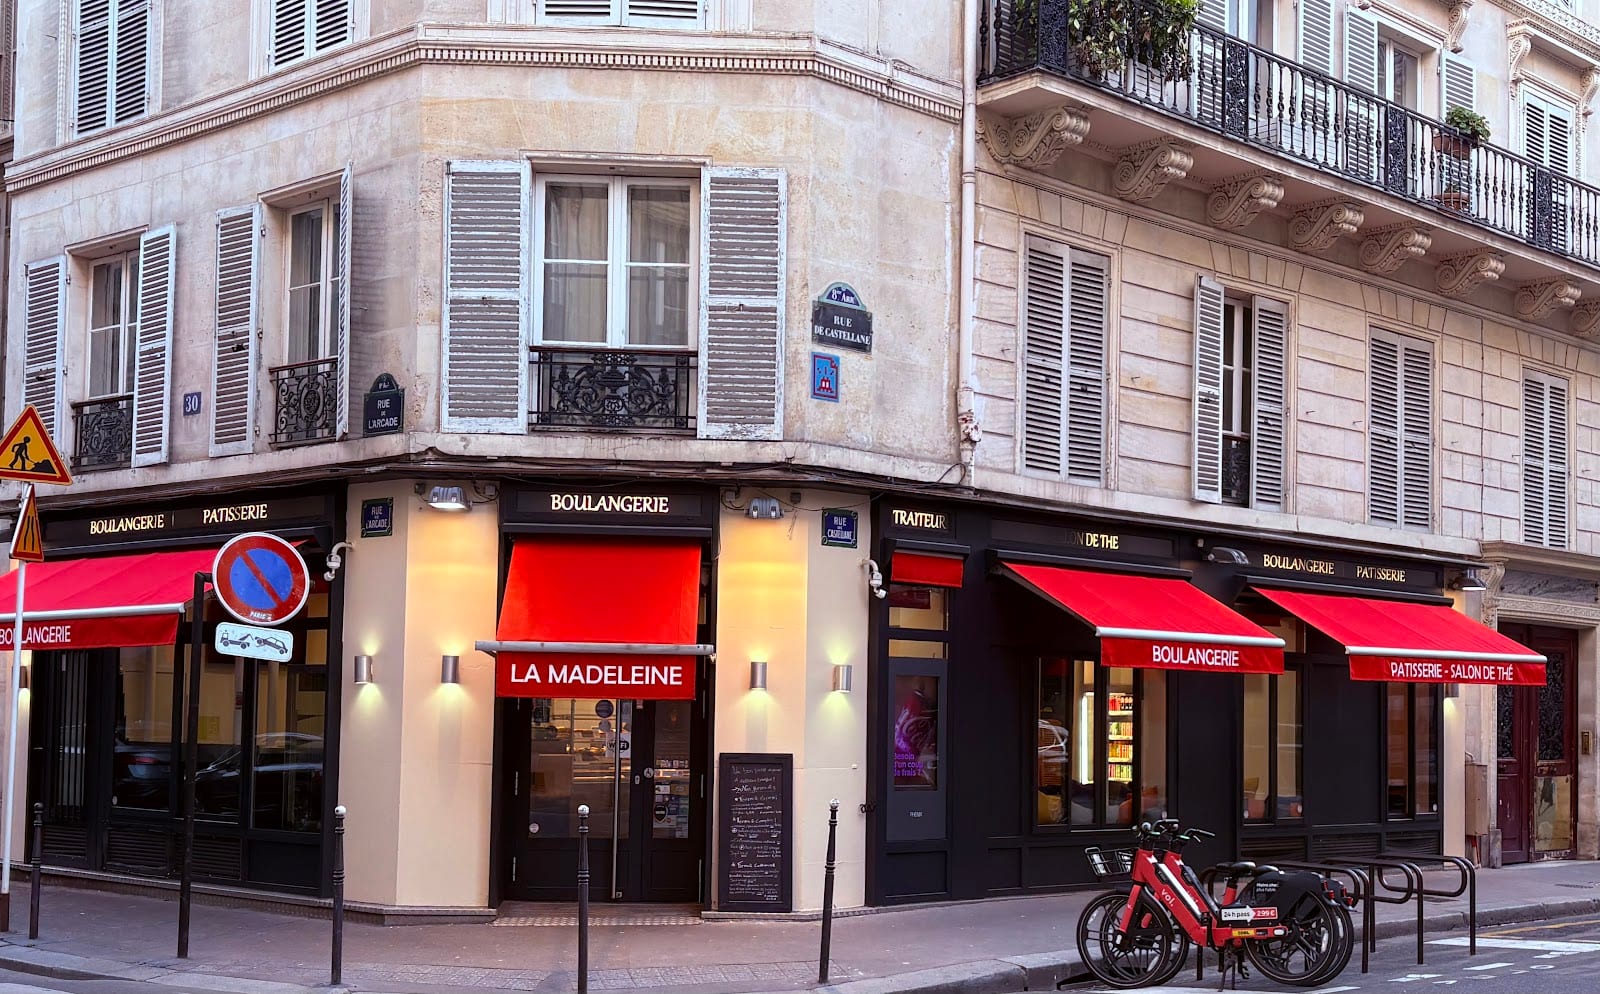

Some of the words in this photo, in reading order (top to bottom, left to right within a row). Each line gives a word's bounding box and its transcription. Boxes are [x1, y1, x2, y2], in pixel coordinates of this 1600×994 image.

[833, 315, 853, 328] RUE
[814, 325, 825, 336] DE
[825, 328, 871, 345] CASTELLANE
[185, 395, 199, 412] 30
[377, 399, 391, 409] RUE
[368, 417, 399, 429] L'ARCADE
[371, 505, 383, 515] RUE
[550, 494, 670, 514] BOULANGERIE
[89, 514, 165, 535] BOULANGERIE
[202, 504, 268, 525] PATISSERIE
[365, 518, 388, 529] L'ARCADE
[833, 516, 847, 526] RUE
[892, 508, 948, 530] TRAITEUR
[1085, 532, 1099, 548] DE
[1100, 534, 1119, 550] THE
[1263, 554, 1335, 575] BOULANGERIE
[1356, 565, 1406, 583] PATISSERIE
[1152, 645, 1240, 667] BOULANGERIE
[511, 664, 541, 683] LA
[548, 664, 683, 686] MADELEINE
[1391, 661, 1443, 678] PATISSERIE
[1450, 664, 1481, 680] SALON
[1483, 665, 1496, 680] DE
[1496, 663, 1514, 681] THÉ
[1236, 911, 1250, 919] pass
